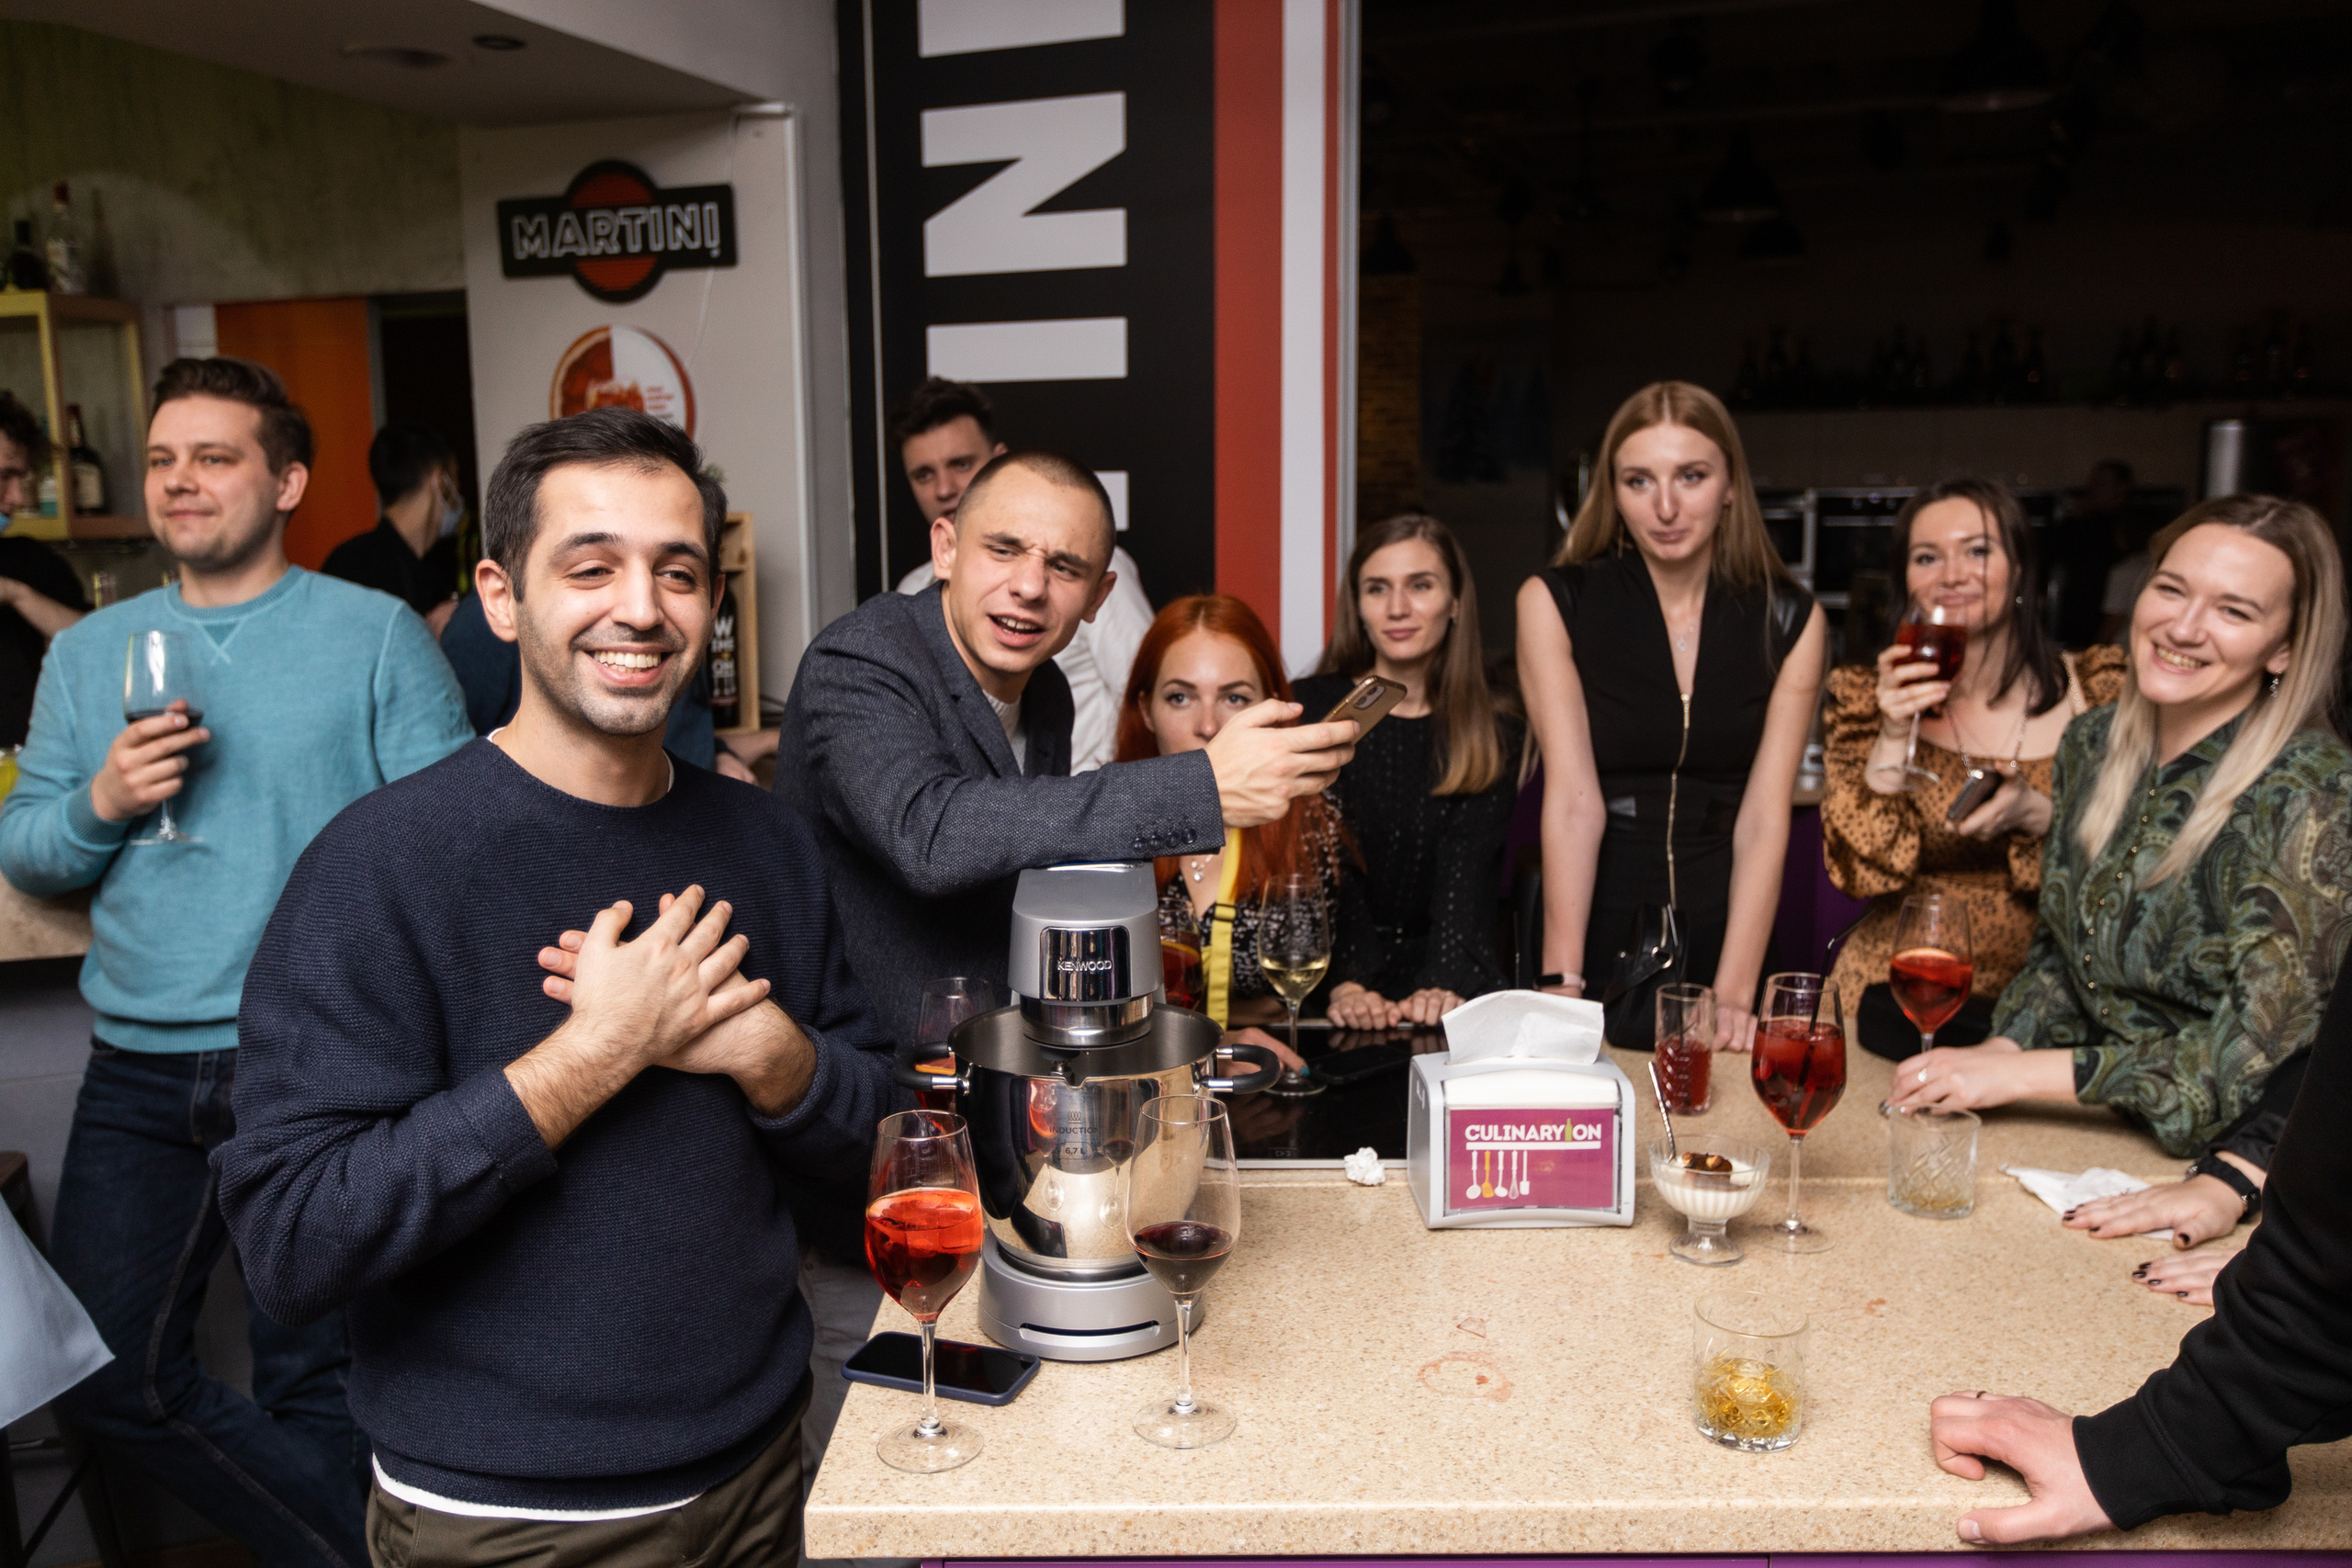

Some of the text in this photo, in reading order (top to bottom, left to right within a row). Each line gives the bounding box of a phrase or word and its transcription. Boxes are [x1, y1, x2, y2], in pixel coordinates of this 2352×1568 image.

[511, 202, 720, 260] MARTINI
[918, 0, 1129, 531] INI
[1057, 960, 1112, 971] KENWOOD
